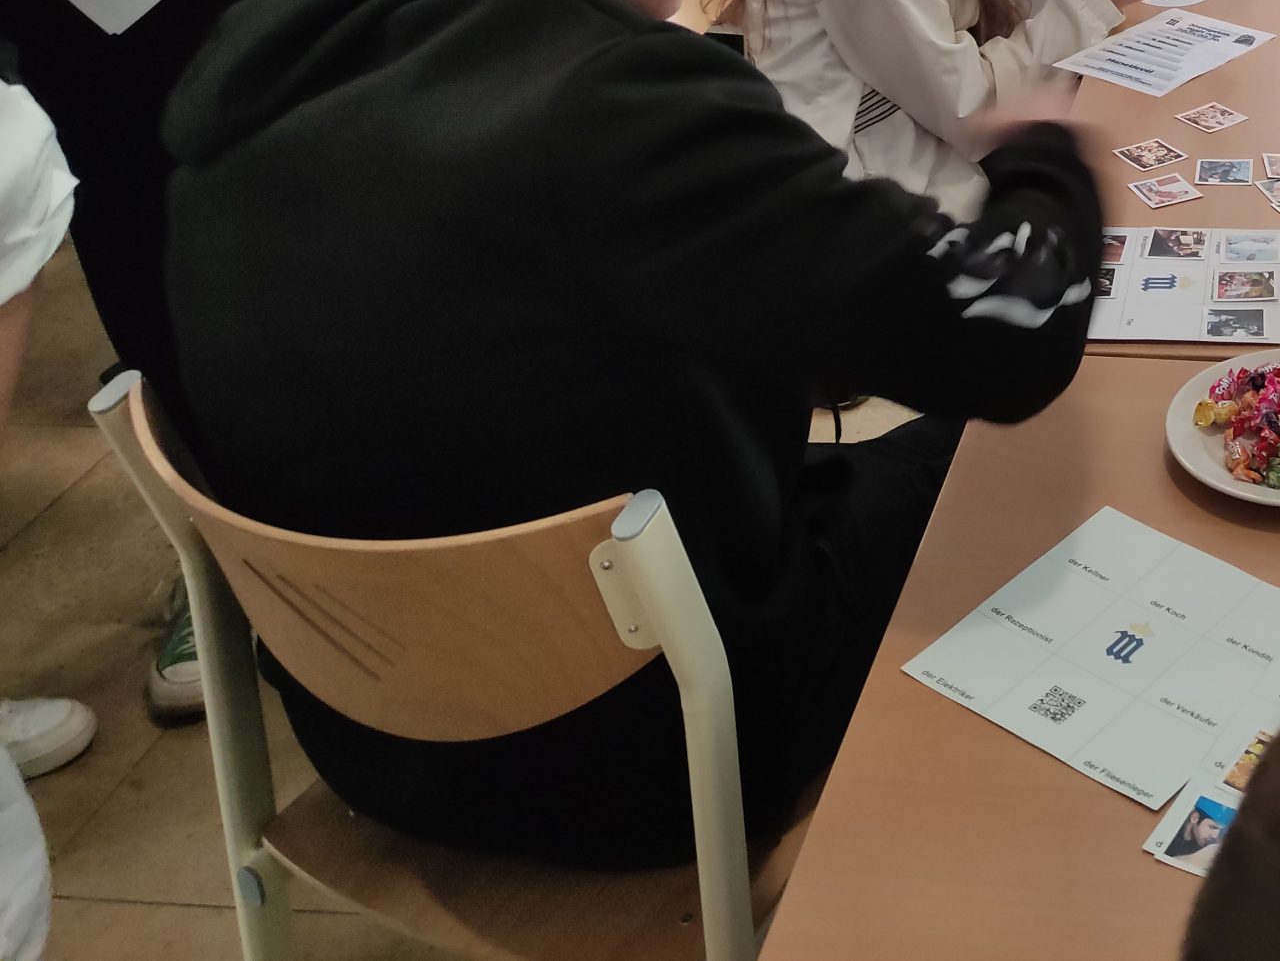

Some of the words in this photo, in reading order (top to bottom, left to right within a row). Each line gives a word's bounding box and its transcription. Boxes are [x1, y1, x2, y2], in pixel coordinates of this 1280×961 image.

[1082, 564, 1111, 583] Kellner
[990, 606, 1004, 619] der
[1165, 606, 1187, 621] Koch
[1226, 636, 1242, 648] der
[921, 668, 937, 682] der
[1159, 695, 1176, 708] der
[1174, 703, 1218, 729] Verkäufer
[1083, 759, 1100, 772] der
[1098, 767, 1155, 801] Fliesenleger
